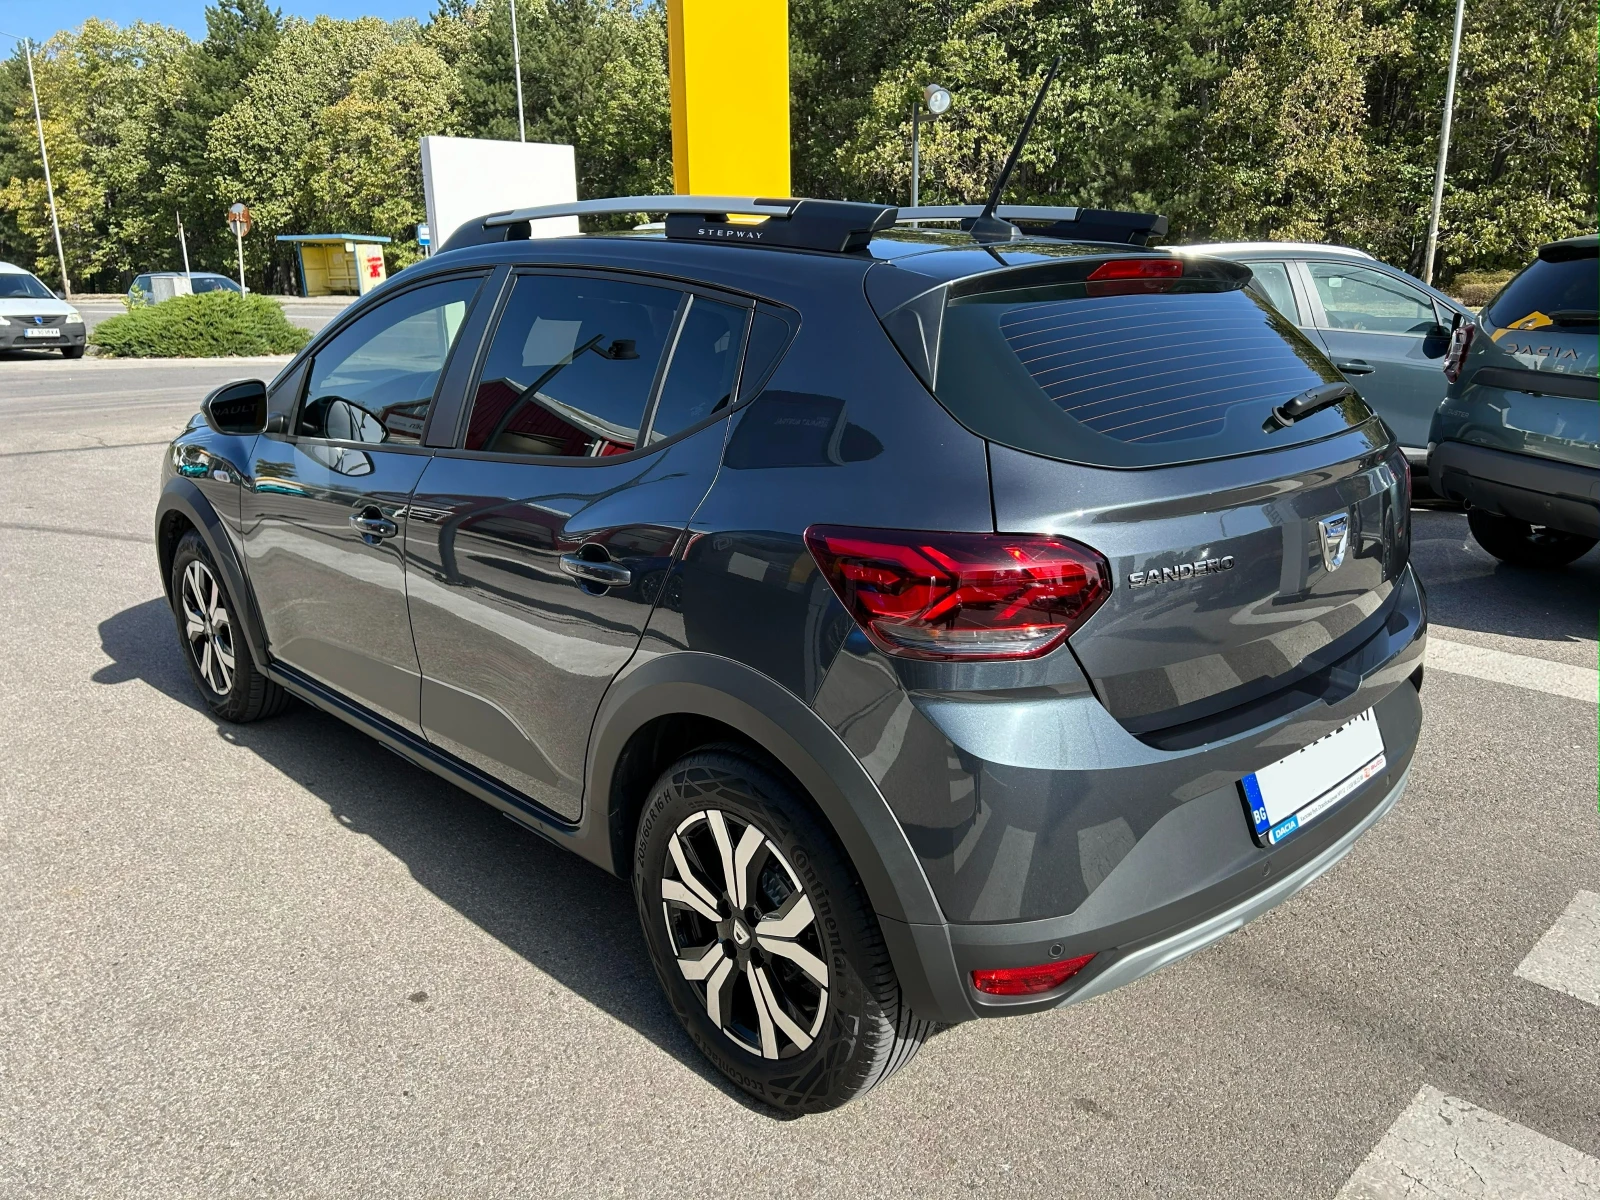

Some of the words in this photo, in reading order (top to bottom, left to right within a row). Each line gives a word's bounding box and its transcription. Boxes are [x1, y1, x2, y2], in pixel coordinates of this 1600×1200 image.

[698, 228, 763, 239] STEPWAY
[1505, 343, 1578, 359] DACIA
[1447, 409, 1470, 418] DUSTER
[1128, 555, 1235, 590] SANDERO
[1253, 807, 1266, 825] BG
[638, 818, 653, 868] 205/60
[649, 808, 658, 822] R
[654, 797, 664, 814] 16
[663, 788, 672, 804] H
[1275, 820, 1297, 838] DACIA
[790, 845, 847, 977] Continental
[702, 1042, 766, 1096] EcoContact
